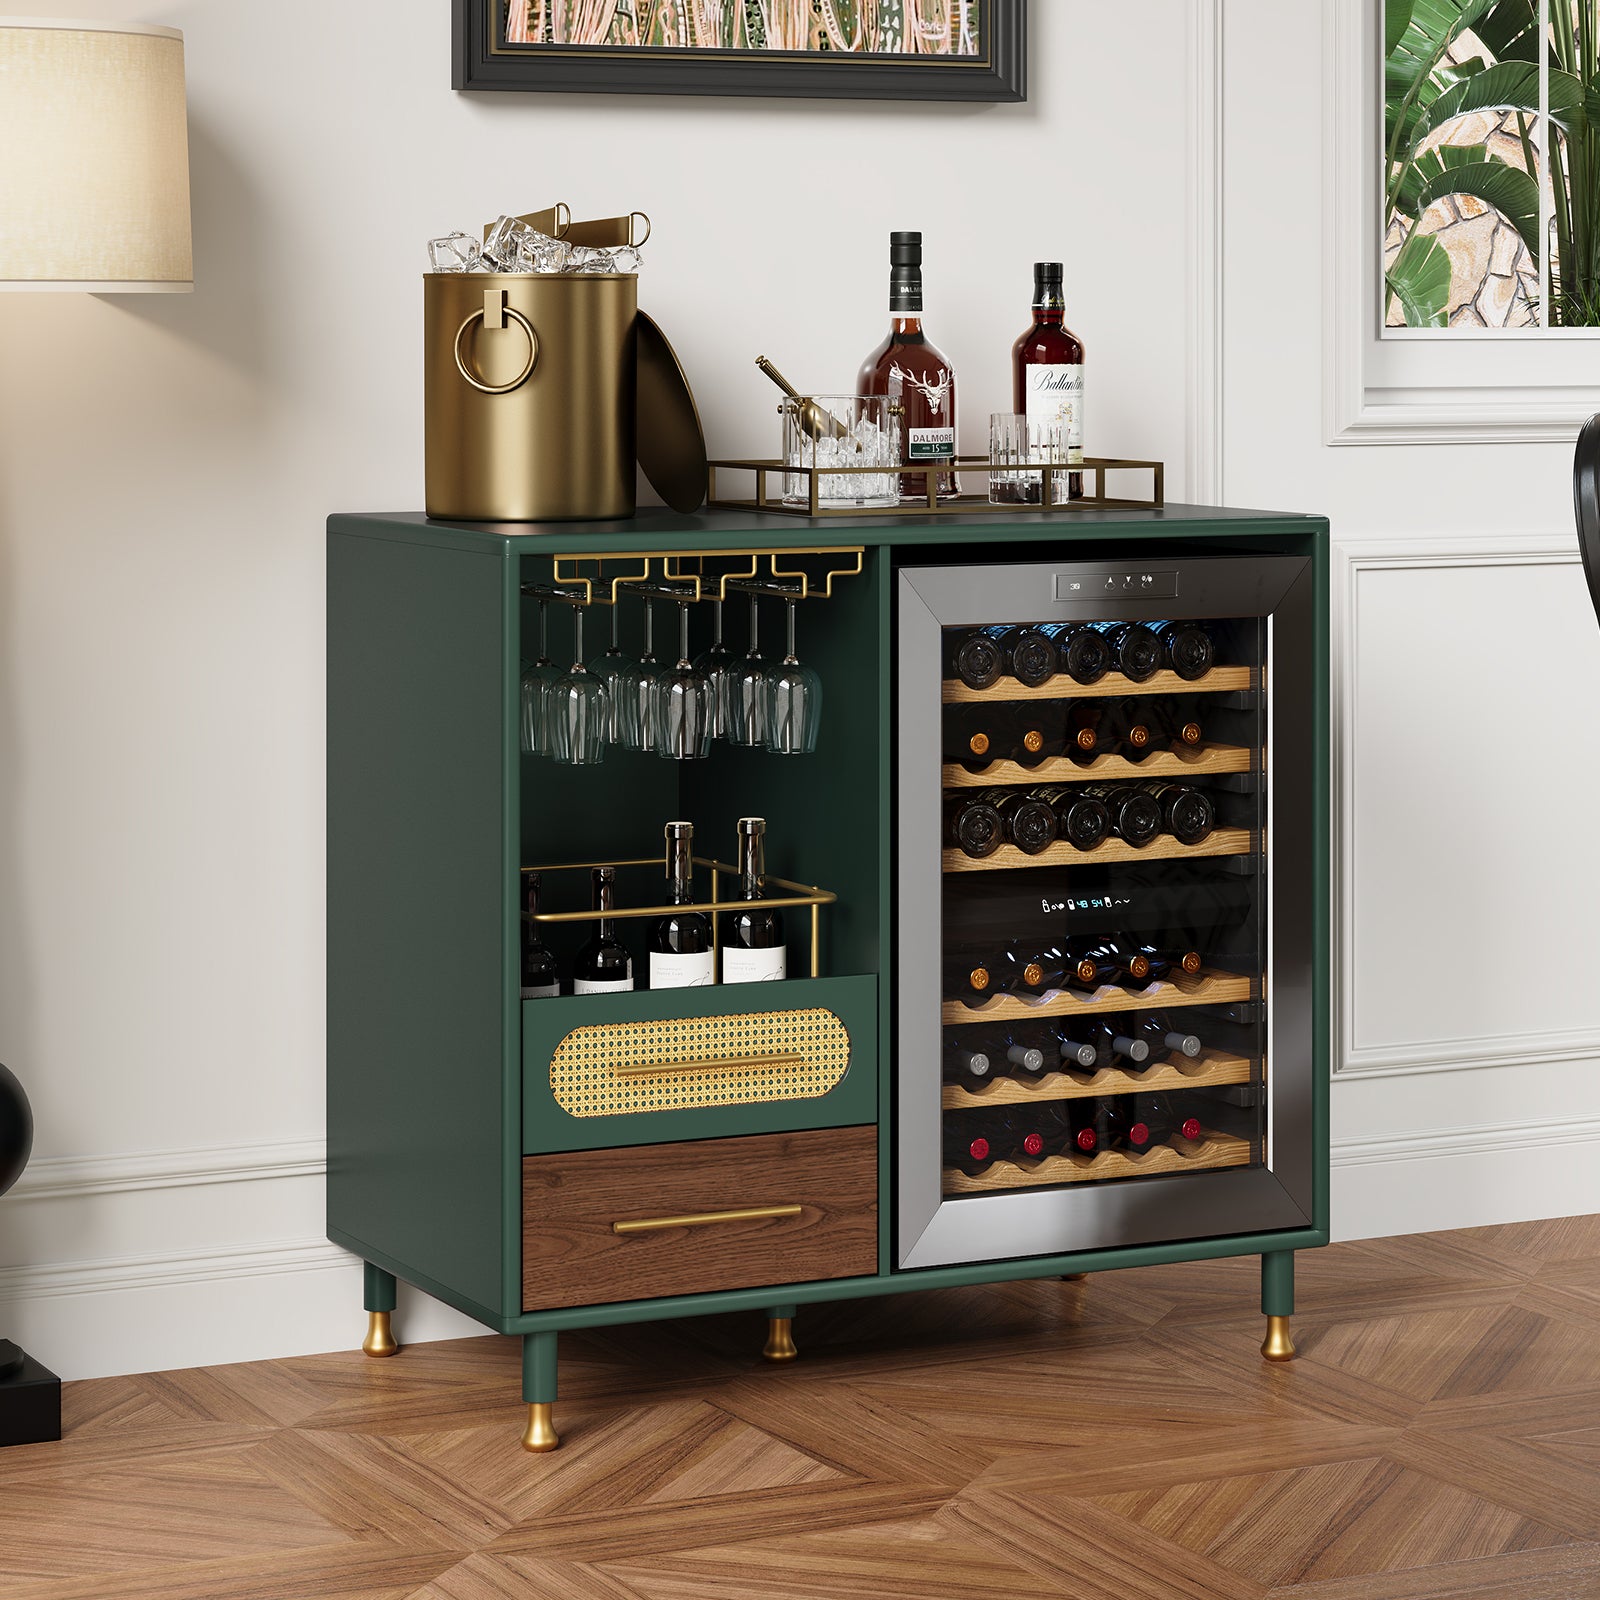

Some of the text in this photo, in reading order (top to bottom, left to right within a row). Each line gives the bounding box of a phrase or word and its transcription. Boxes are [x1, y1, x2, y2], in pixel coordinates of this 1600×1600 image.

[913, 433, 952, 442] DALMORE
[931, 443, 940, 453] 15
[1076, 899, 1103, 908] 48 54
